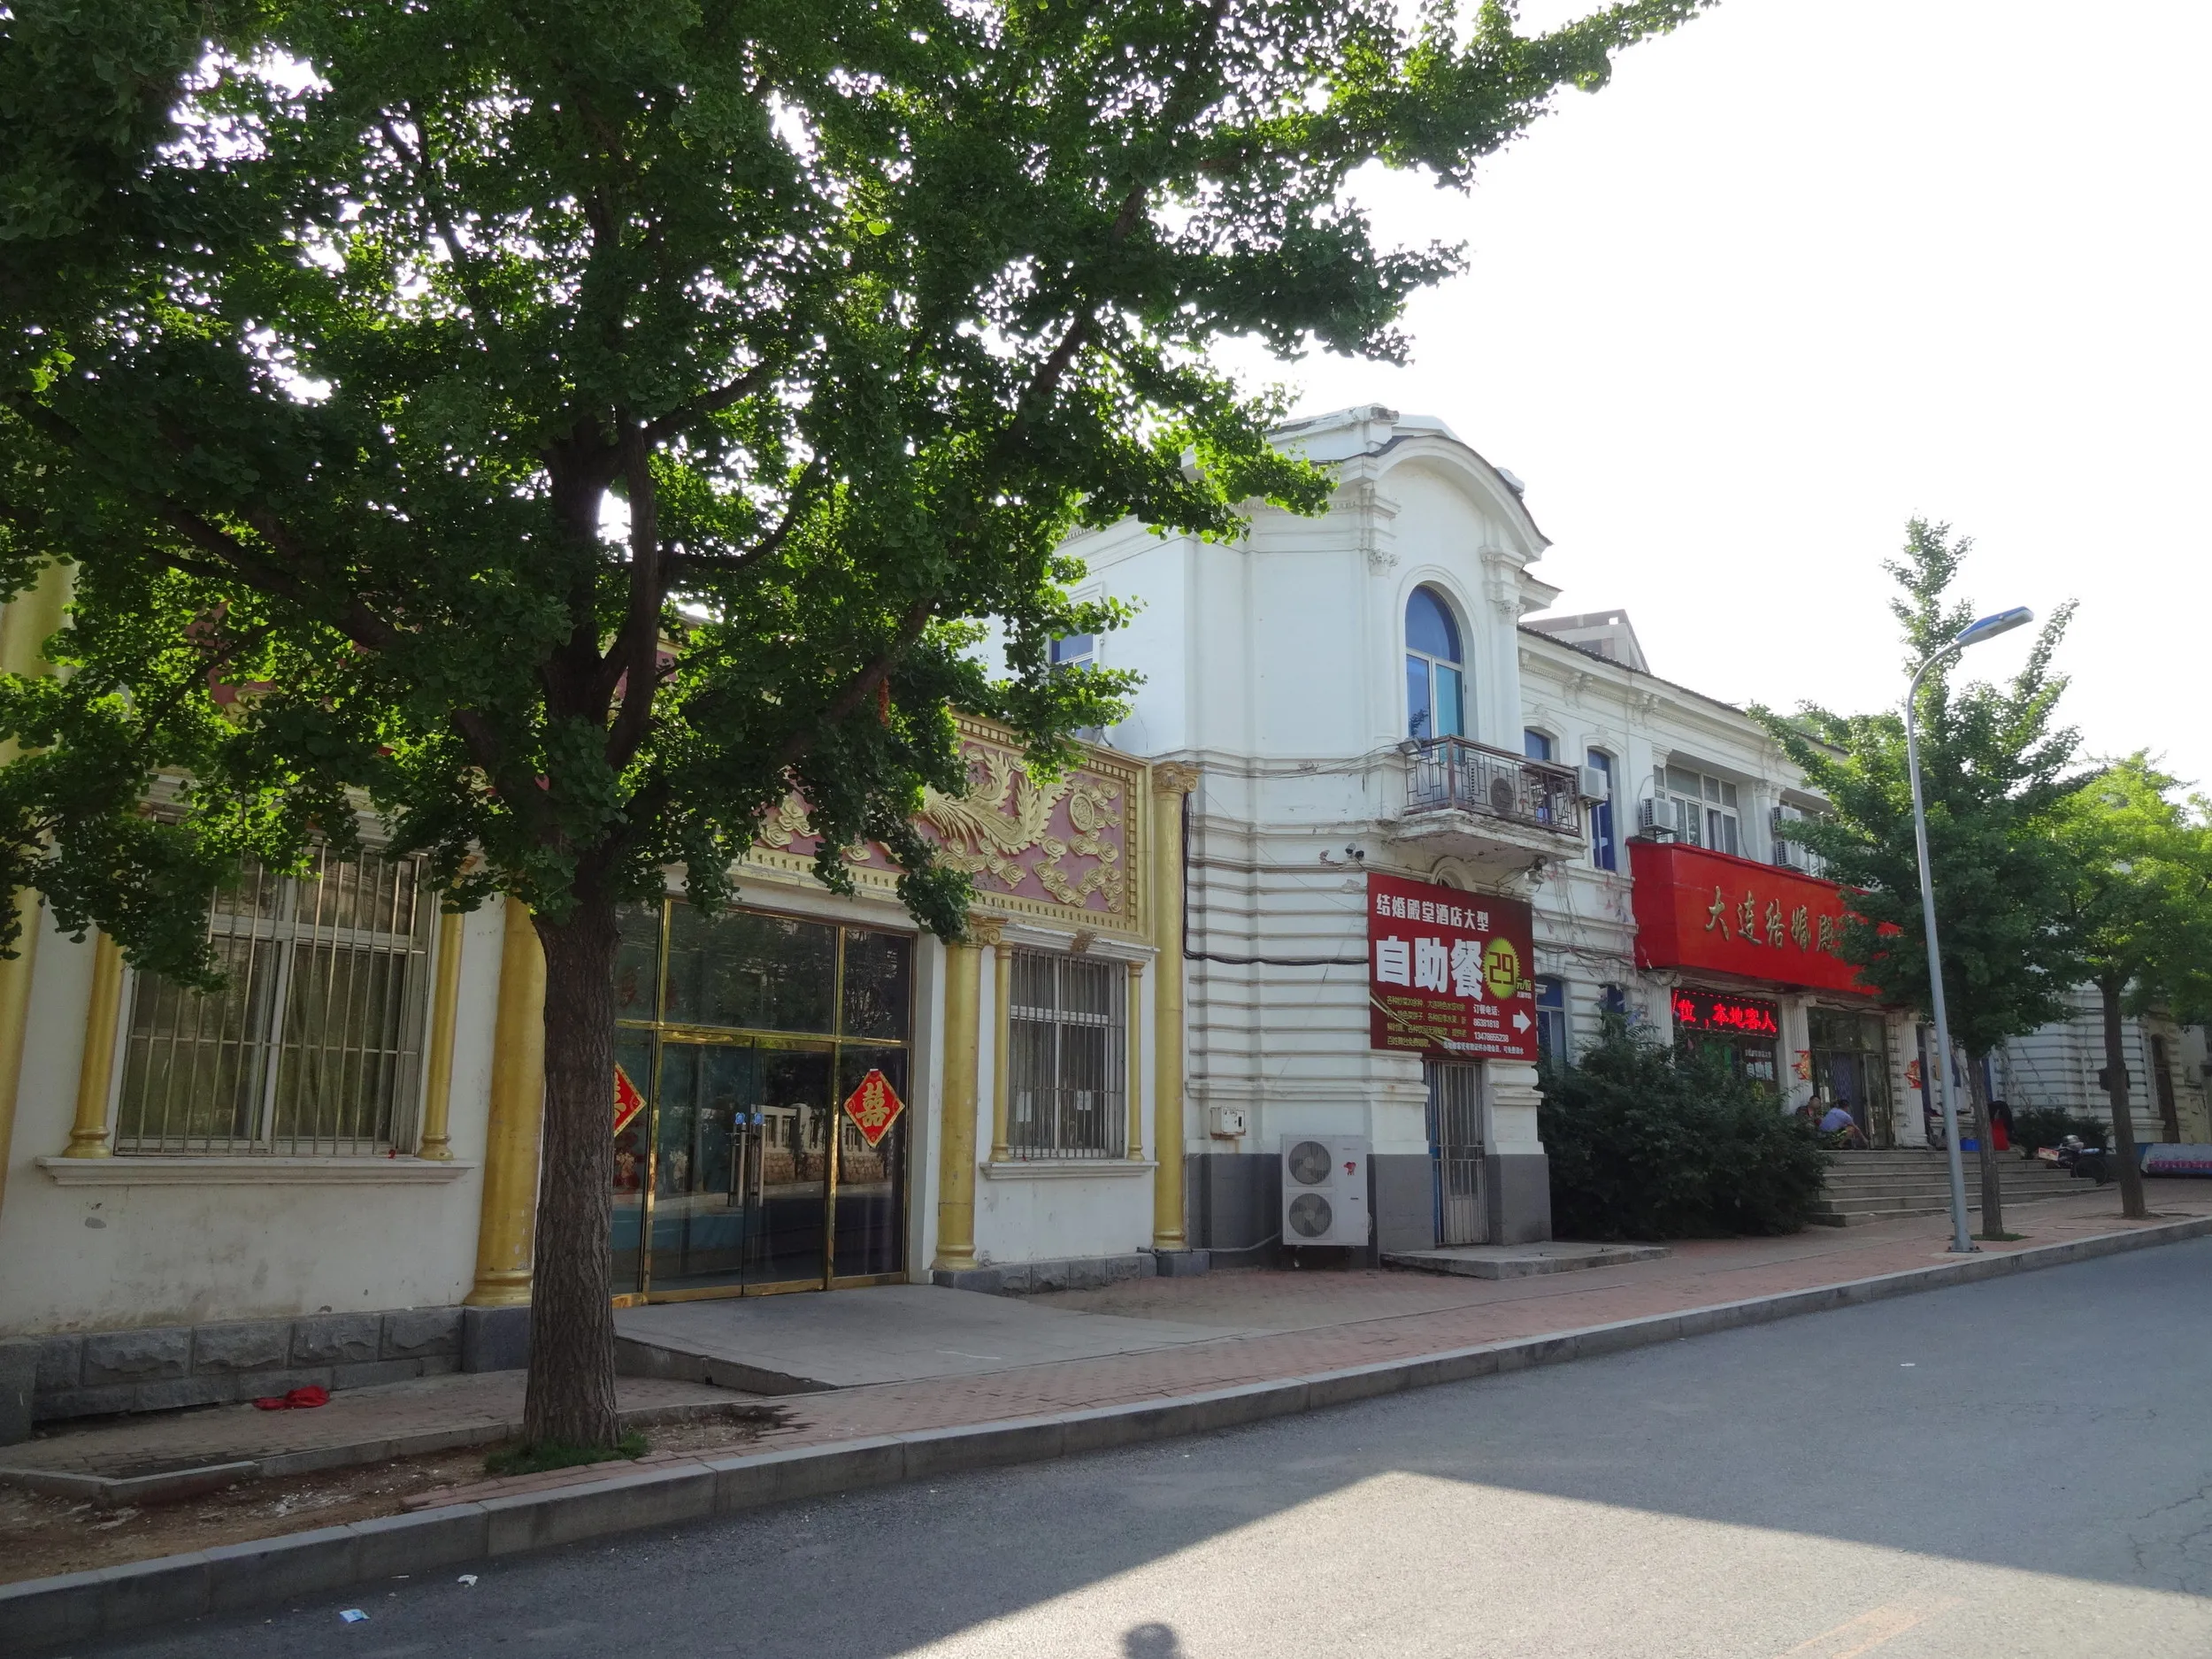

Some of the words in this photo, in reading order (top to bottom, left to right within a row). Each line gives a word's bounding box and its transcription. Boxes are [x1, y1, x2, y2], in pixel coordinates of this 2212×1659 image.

[1376, 893, 1489, 933] 结婚殿堂酒店大型
[1376, 935, 1484, 1002] 自助餐
[1488, 951, 1515, 986] 29
